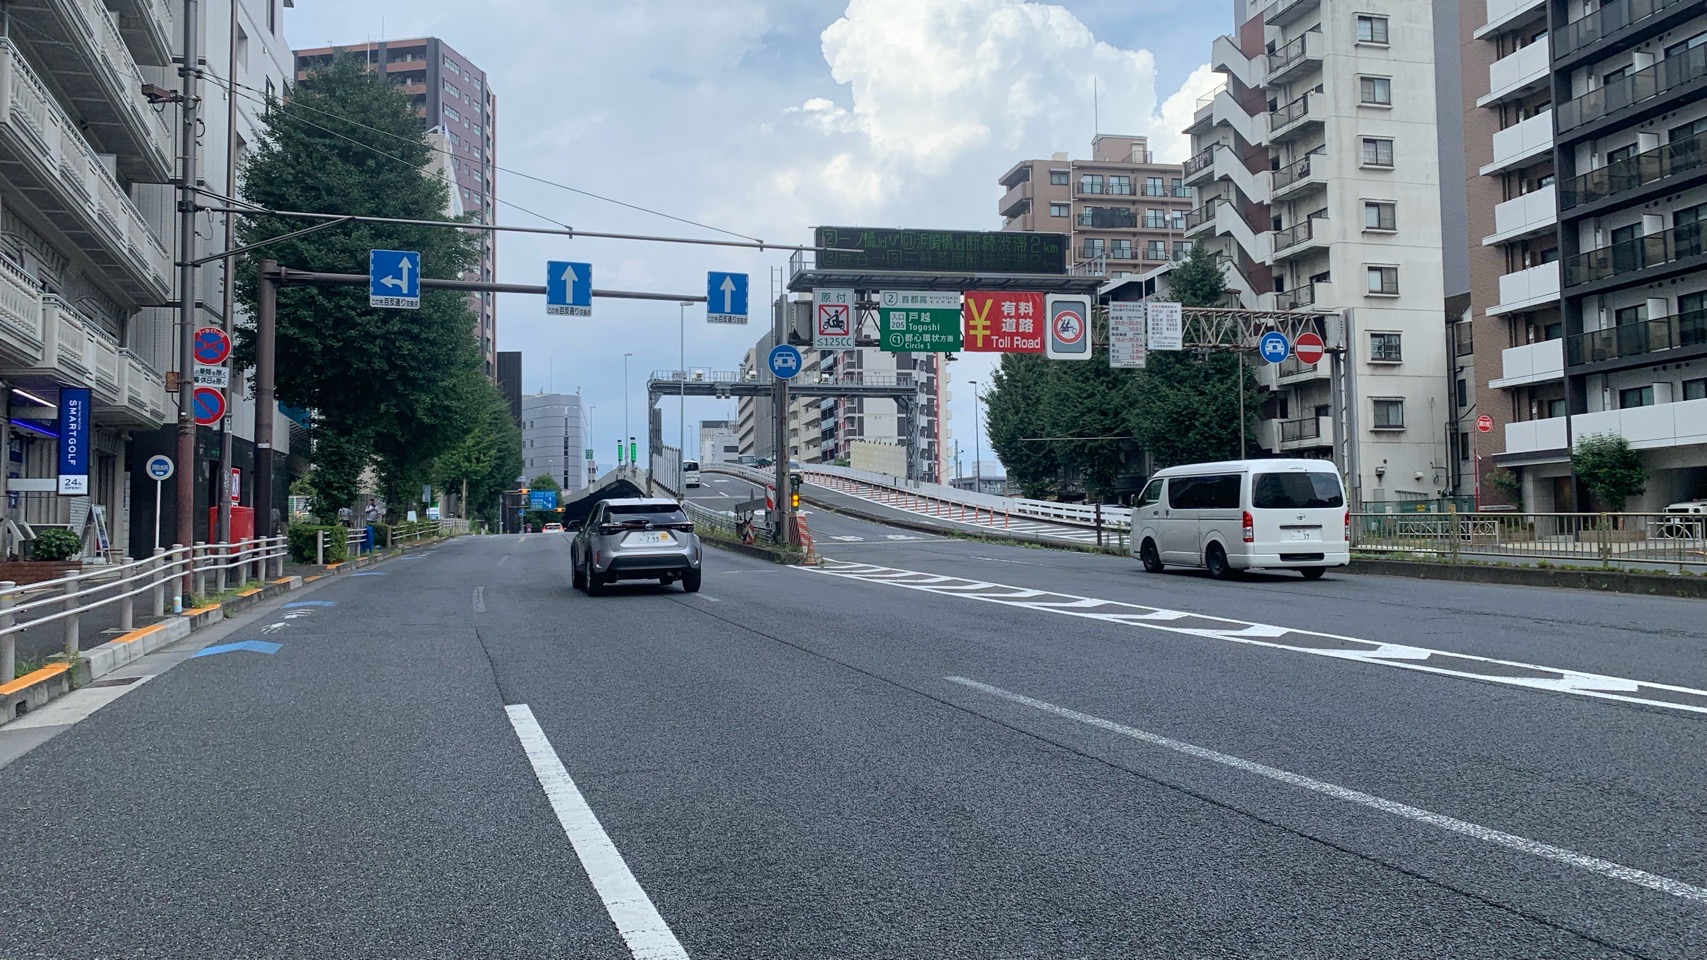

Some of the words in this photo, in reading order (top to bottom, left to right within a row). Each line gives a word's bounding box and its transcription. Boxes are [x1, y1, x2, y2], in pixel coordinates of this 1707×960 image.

[821, 292, 846, 303] 原付
[888, 294, 894, 303] 2
[902, 295, 928, 304] 首都高
[1001, 301, 1033, 317] 有料
[891, 313, 905, 321] 入口
[908, 312, 931, 323] 戸越
[891, 321, 905, 329] 205
[908, 323, 940, 333] Togoshi
[1001, 317, 1034, 333] 道路
[905, 333, 954, 343] 都心環状方面
[991, 335, 1011, 348] Toll
[1013, 336, 1041, 349] Road
